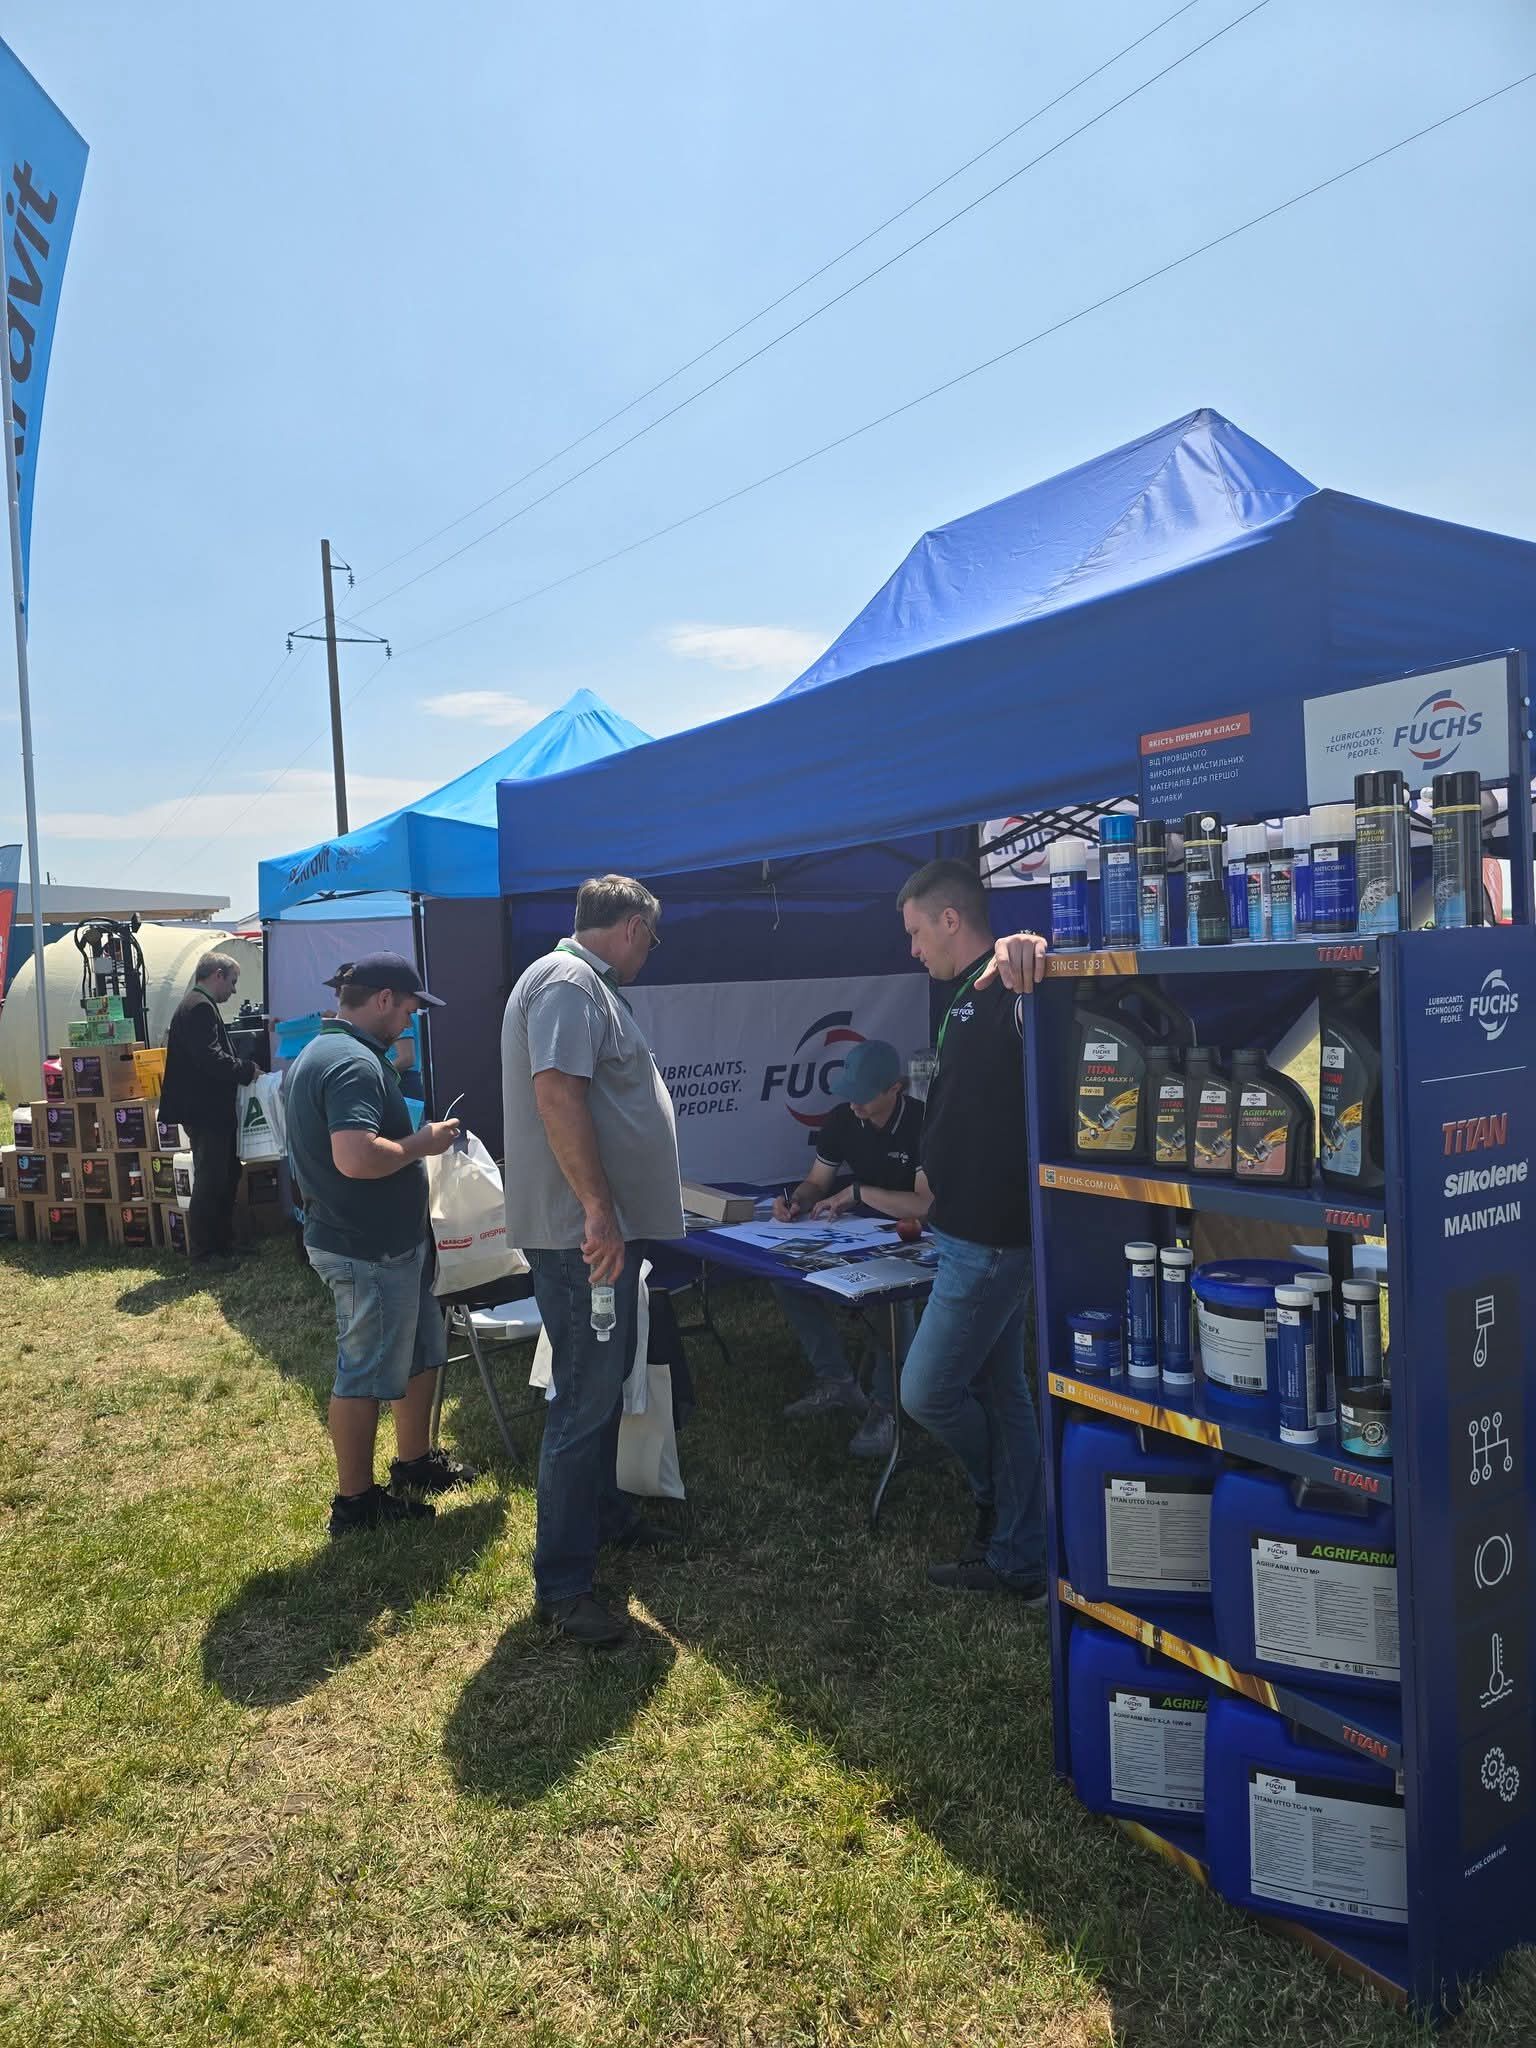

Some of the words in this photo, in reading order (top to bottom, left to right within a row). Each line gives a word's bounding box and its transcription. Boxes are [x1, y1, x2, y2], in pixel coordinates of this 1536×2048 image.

[1148, 738, 1174, 748] ЯКІСТЬ
[1175, 729, 1212, 743] ПРЕМІУМ
[1213, 722, 1241, 734] КЛАСУ
[1331, 726, 1385, 743] LUBRICANTS.
[1393, 712, 1483, 748] FUCHS
[1325, 737, 1383, 754] TECHNOLOGY.
[1347, 747, 1381, 760] PEOPLE.
[1149, 757, 1160, 767] ВІД
[1162, 749, 1207, 765] ПРОВІДНОГО
[1150, 766, 1191, 779] ВИРОБНИКА
[1193, 754, 1245, 771] МАСТИЛЬНИХ
[1150, 778, 1191, 791] МАТЕРІАЛІВ
[1192, 775, 1207, 786] ДЛЯ
[1209, 768, 1239, 781] ПЕРШОЇ
[1151, 793, 1183, 805] ЗАЛИВКИ
[1051, 960, 1080, 971] SINCE
[1083, 959, 1105, 970] 1931
[1429, 995, 1464, 1006] LUBRICANTS.
[1469, 993, 1519, 1017] FUCHS
[1425, 1005, 1463, 1016] TECHNOLOGY.
[1440, 1014, 1462, 1024] PEOPLE.
[662, 1060, 747, 1081] UBRICANTS.
[669, 1079, 743, 1099] HNOLOGY.
[760, 1060, 845, 1101] FUC
[677, 1098, 739, 1117] PEOPLE.
[1242, 1109, 1287, 1117] AGRIFARM
[1442, 1112, 1508, 1155] TITAN
[1059, 1175, 1119, 1191] FUCHS.COM/UA
[1443, 1160, 1528, 1198] Silkolene
[1325, 1209, 1371, 1228] TITAN
[1444, 1201, 1521, 1238] MAINTAIN
[1332, 1466, 1379, 1493] TITAN
[1110, 1496, 1127, 1504] TITAN
[1267, 1547, 1288, 1556] FUCHS
[1311, 1545, 1395, 1565] AGRIFARM
[1256, 1560, 1290, 1571] AGRIFARM
[1291, 1566, 1309, 1574] UTTO
[1113, 1712, 1143, 1720] AGRIFARM
[1343, 1725, 1388, 1758] TITAN
[1265, 1782, 1287, 1791] FUCHS
[1254, 1794, 1272, 1803] TITAN
[1273, 1799, 1291, 1808] UTTO
